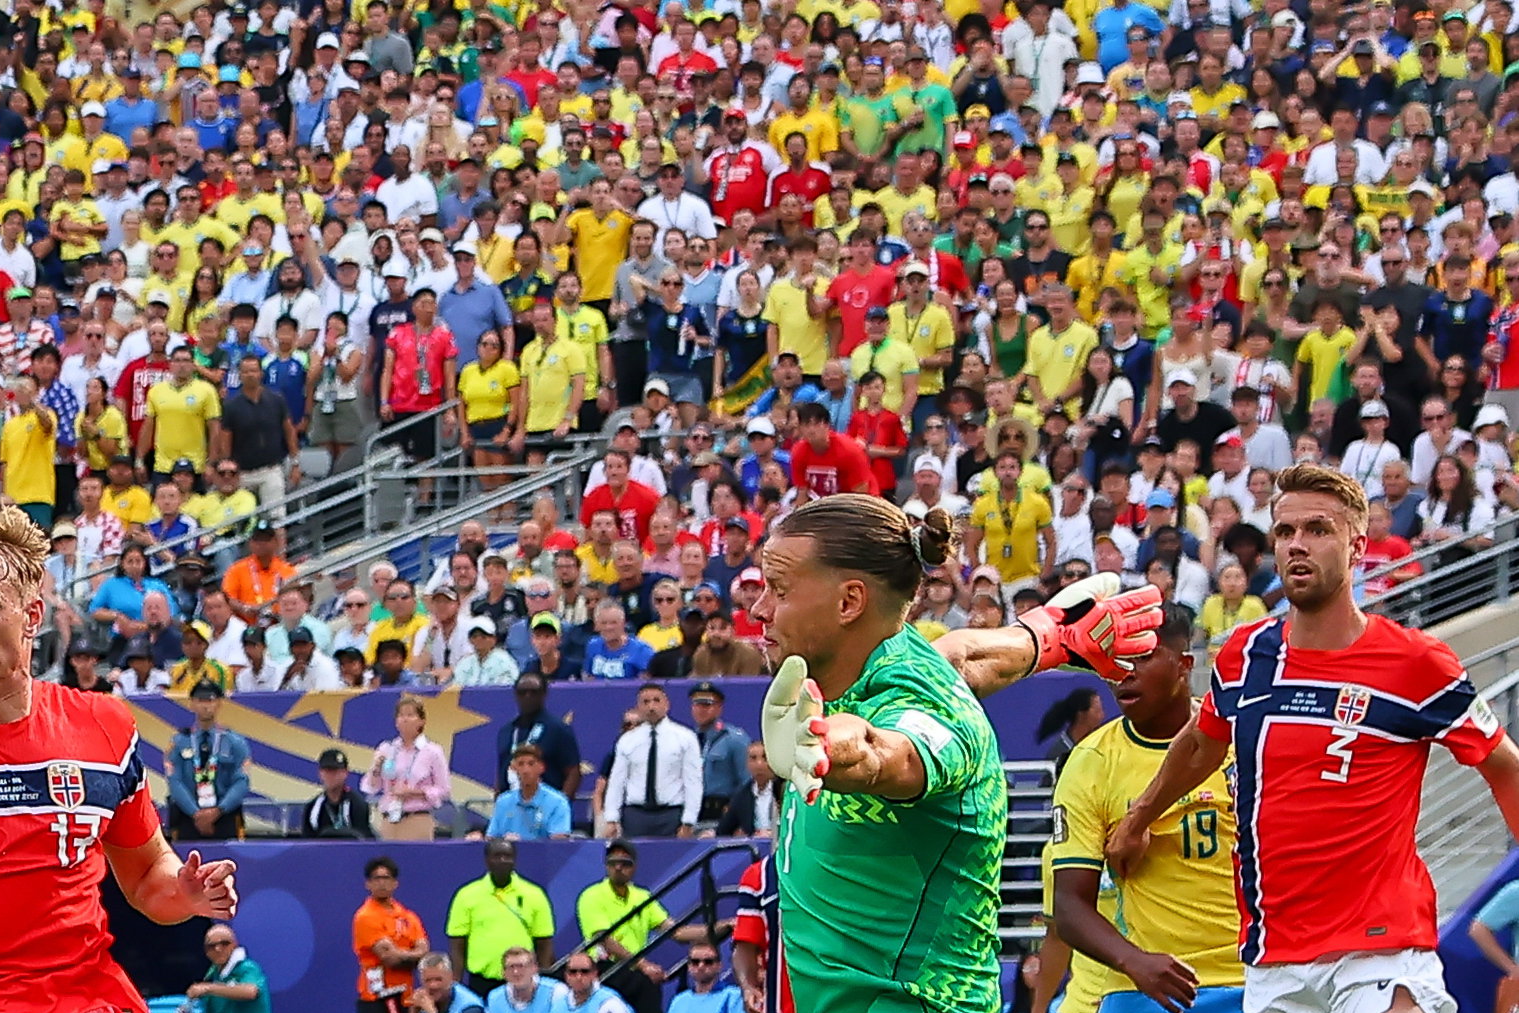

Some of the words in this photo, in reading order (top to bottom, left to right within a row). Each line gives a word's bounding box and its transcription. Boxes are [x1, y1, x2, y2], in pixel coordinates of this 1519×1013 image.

[1321, 727, 1358, 783] 3
[51, 814, 101, 868] 17
[1180, 809, 1218, 859] 19
